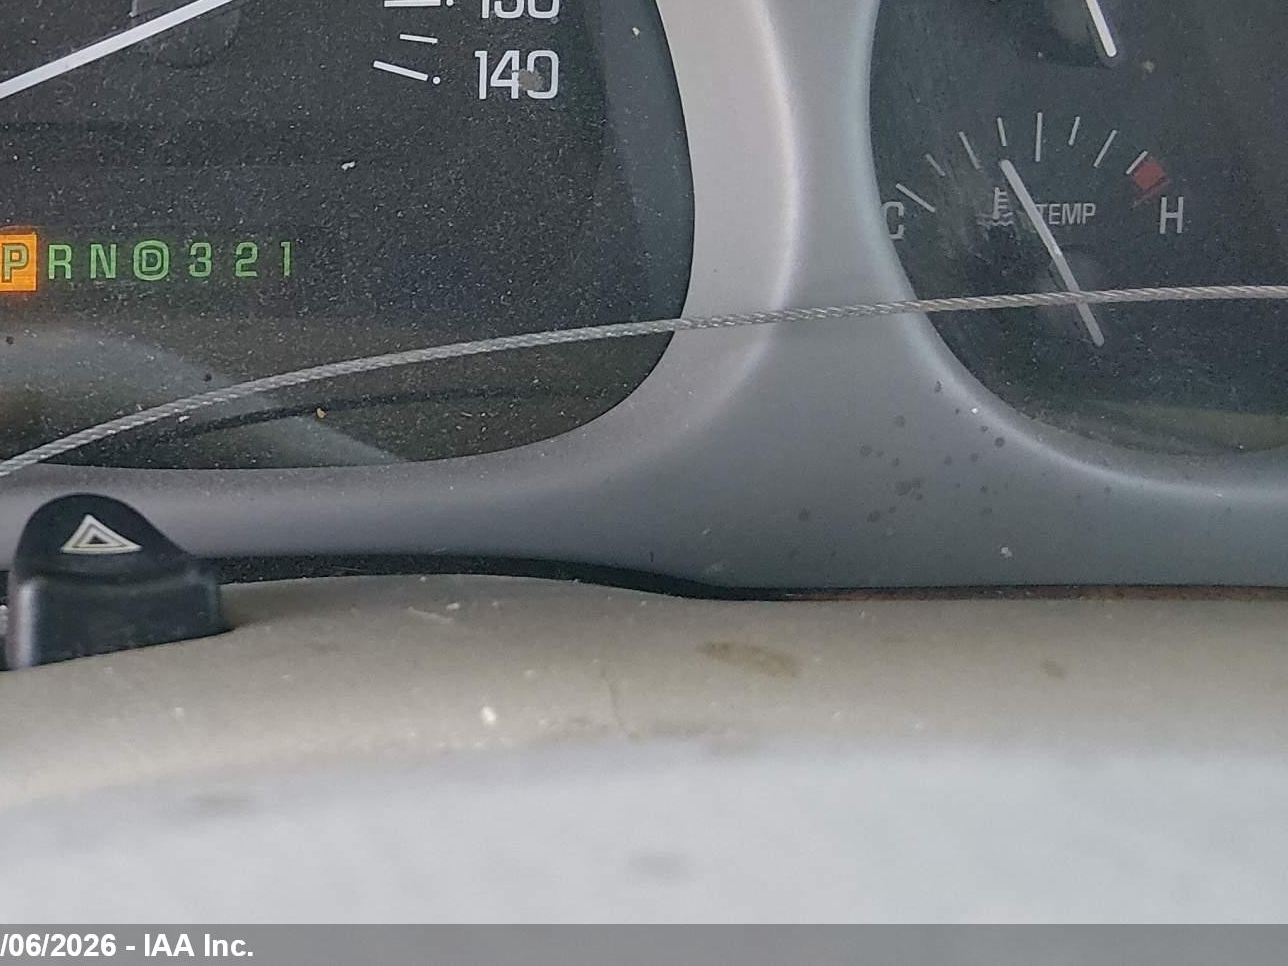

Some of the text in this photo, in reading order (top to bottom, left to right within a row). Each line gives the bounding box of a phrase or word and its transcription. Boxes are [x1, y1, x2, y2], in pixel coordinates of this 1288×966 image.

[475, 49, 561, 101] 140
[1035, 202, 1097, 226] TEMP
[1159, 196, 1184, 235] H
[2, 243, 30, 282] P
[48, 243, 73, 280] R
[90, 243, 117, 279] N
[188, 241, 213, 278] 3
[235, 241, 259, 278] 2
[280, 240, 292, 277] 1
